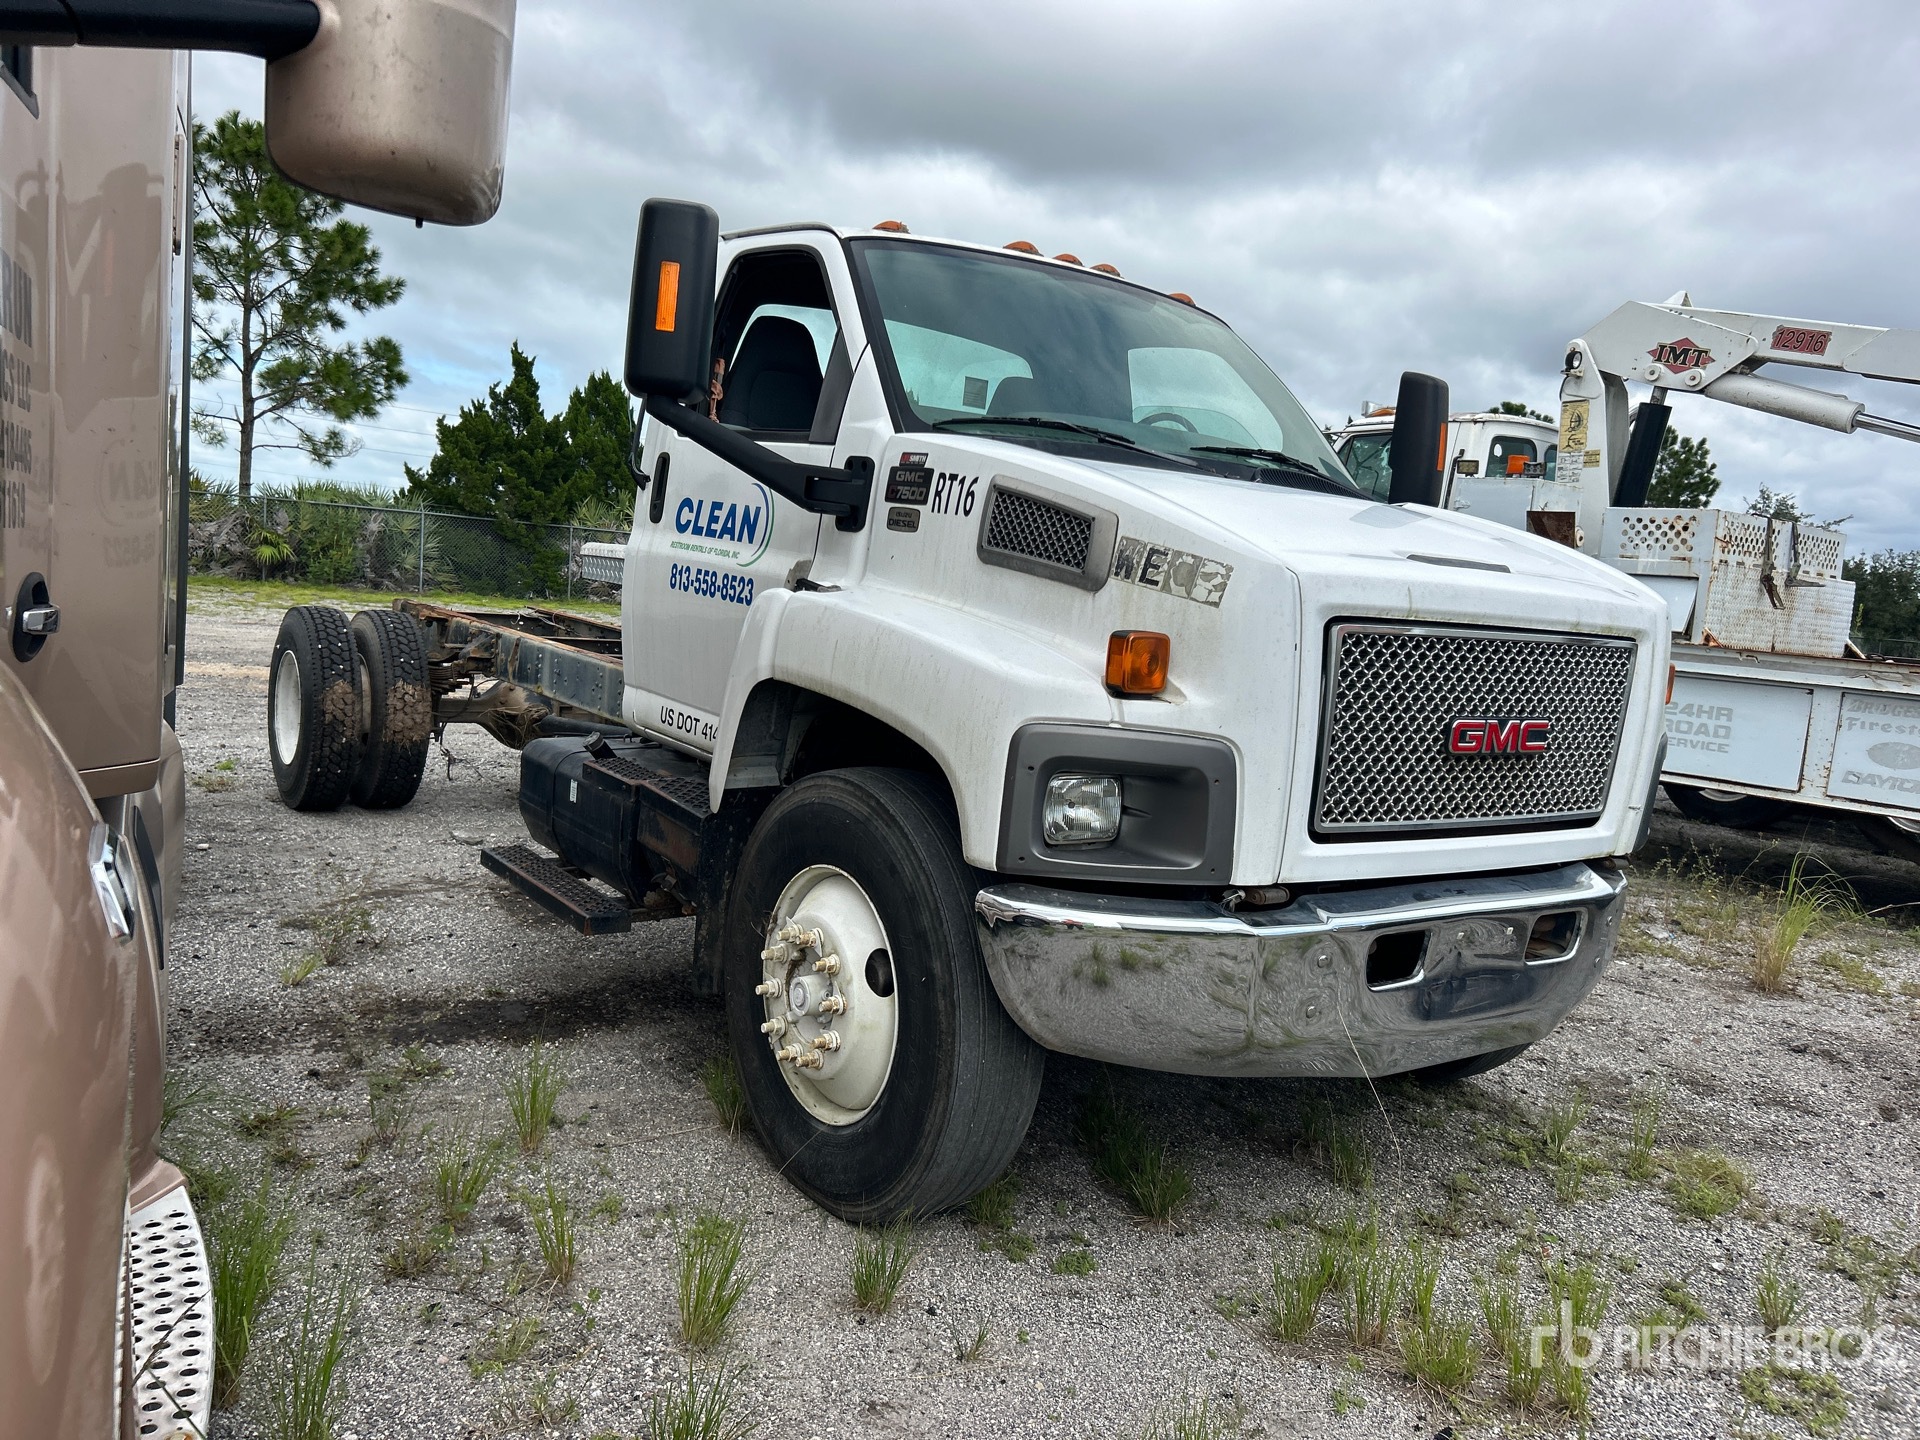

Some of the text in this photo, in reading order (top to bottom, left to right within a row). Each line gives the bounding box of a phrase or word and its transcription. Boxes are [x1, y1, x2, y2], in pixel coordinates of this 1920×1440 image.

[1774, 329, 1828, 352] 12916
[1654, 343, 1709, 368] IMT
[17, 358, 31, 413] LLC
[896, 471, 925, 483] GMC
[889, 485, 927, 500] C7500
[931, 472, 980, 517] RT16
[675, 496, 762, 545] CLEAN
[888, 518, 916, 529] DIESEL
[671, 541, 691, 551] RESTROOM
[691, 544, 707, 554] RENTALS
[669, 563, 756, 607] 813-558-8523
[661, 705, 675, 727] US
[677, 711, 701, 736] DOT
[1664, 701, 1734, 723] 24HR
[1449, 719, 1550, 753] GMC
[1845, 716, 1920, 737] Firest
[1667, 736, 1730, 754] ERVICE
